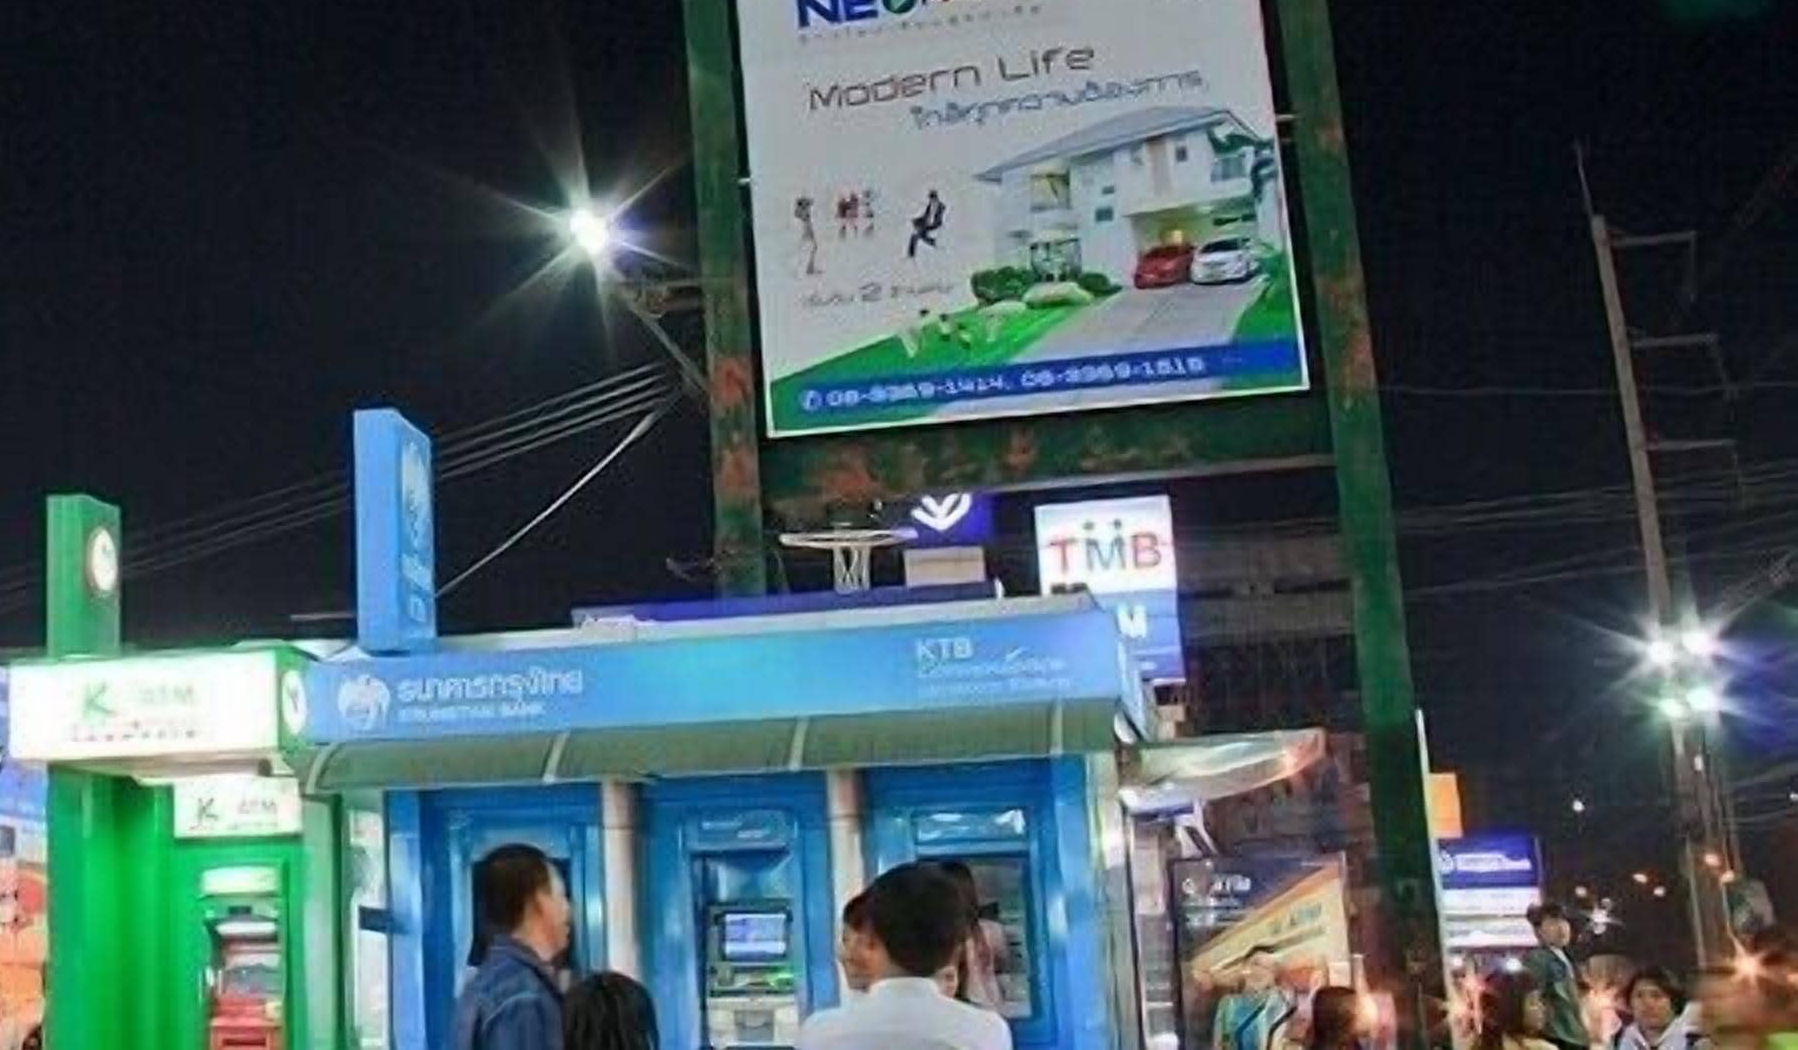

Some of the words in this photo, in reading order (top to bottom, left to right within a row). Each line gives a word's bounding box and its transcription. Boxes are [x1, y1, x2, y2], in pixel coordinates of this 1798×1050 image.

[807, 65, 983, 112] Modern
[997, 45, 1095, 82] Life
[1049, 526, 1162, 575] TMB
